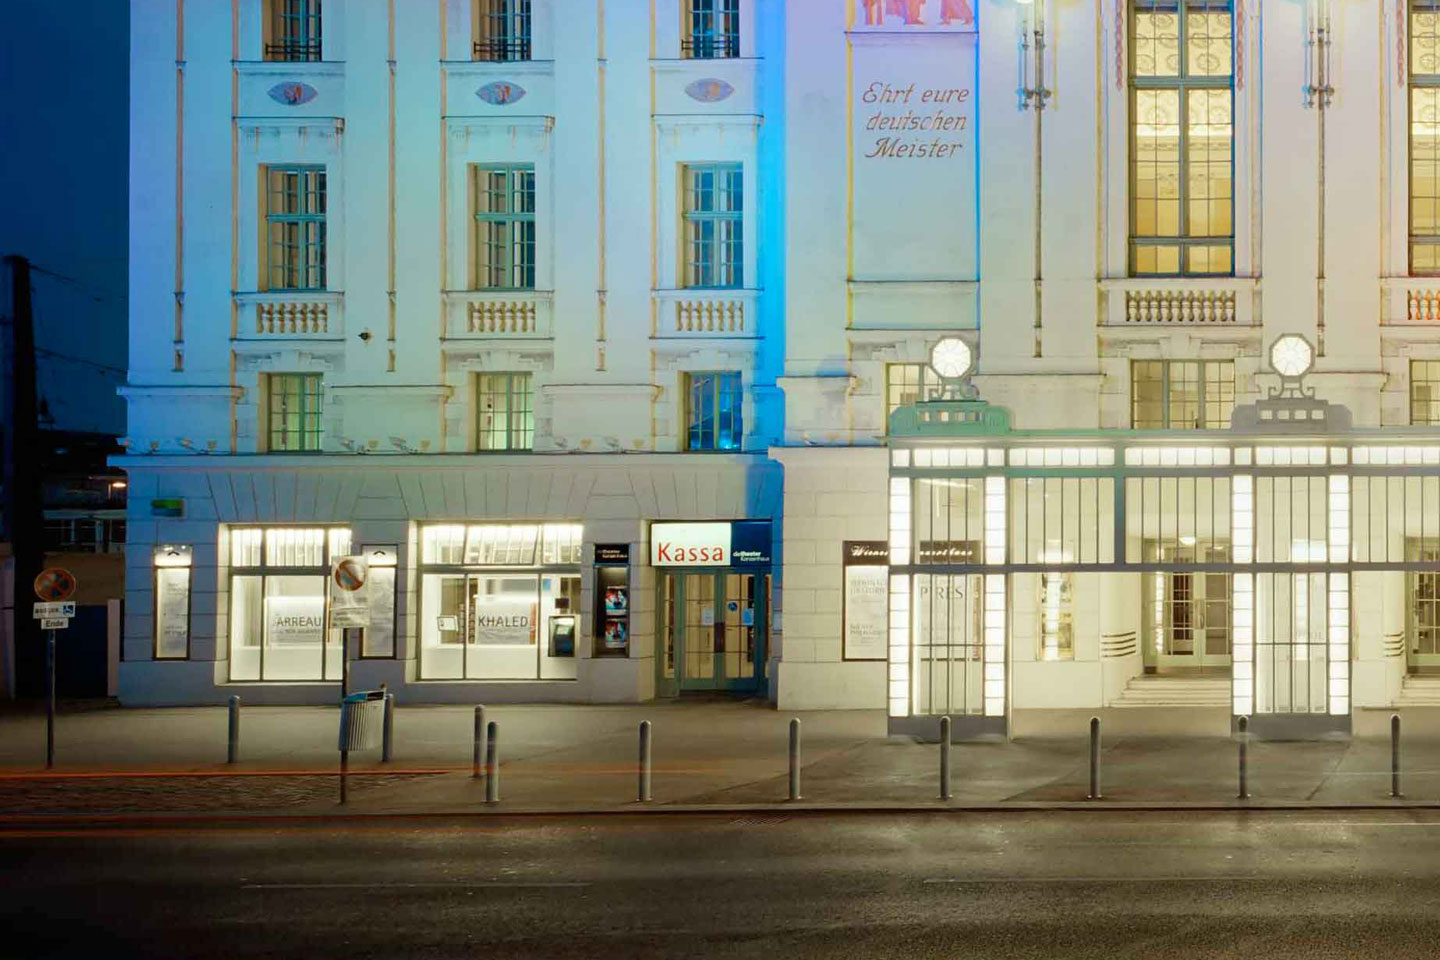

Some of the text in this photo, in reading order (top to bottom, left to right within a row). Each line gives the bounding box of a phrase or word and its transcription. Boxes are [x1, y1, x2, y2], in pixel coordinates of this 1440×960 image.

[862, 81, 970, 104] Ehrt eure
[866, 110, 967, 131] deutschen
[865, 136, 963, 159] Meister
[658, 542, 724, 562] Kassa
[478, 616, 528, 628] KHALED
